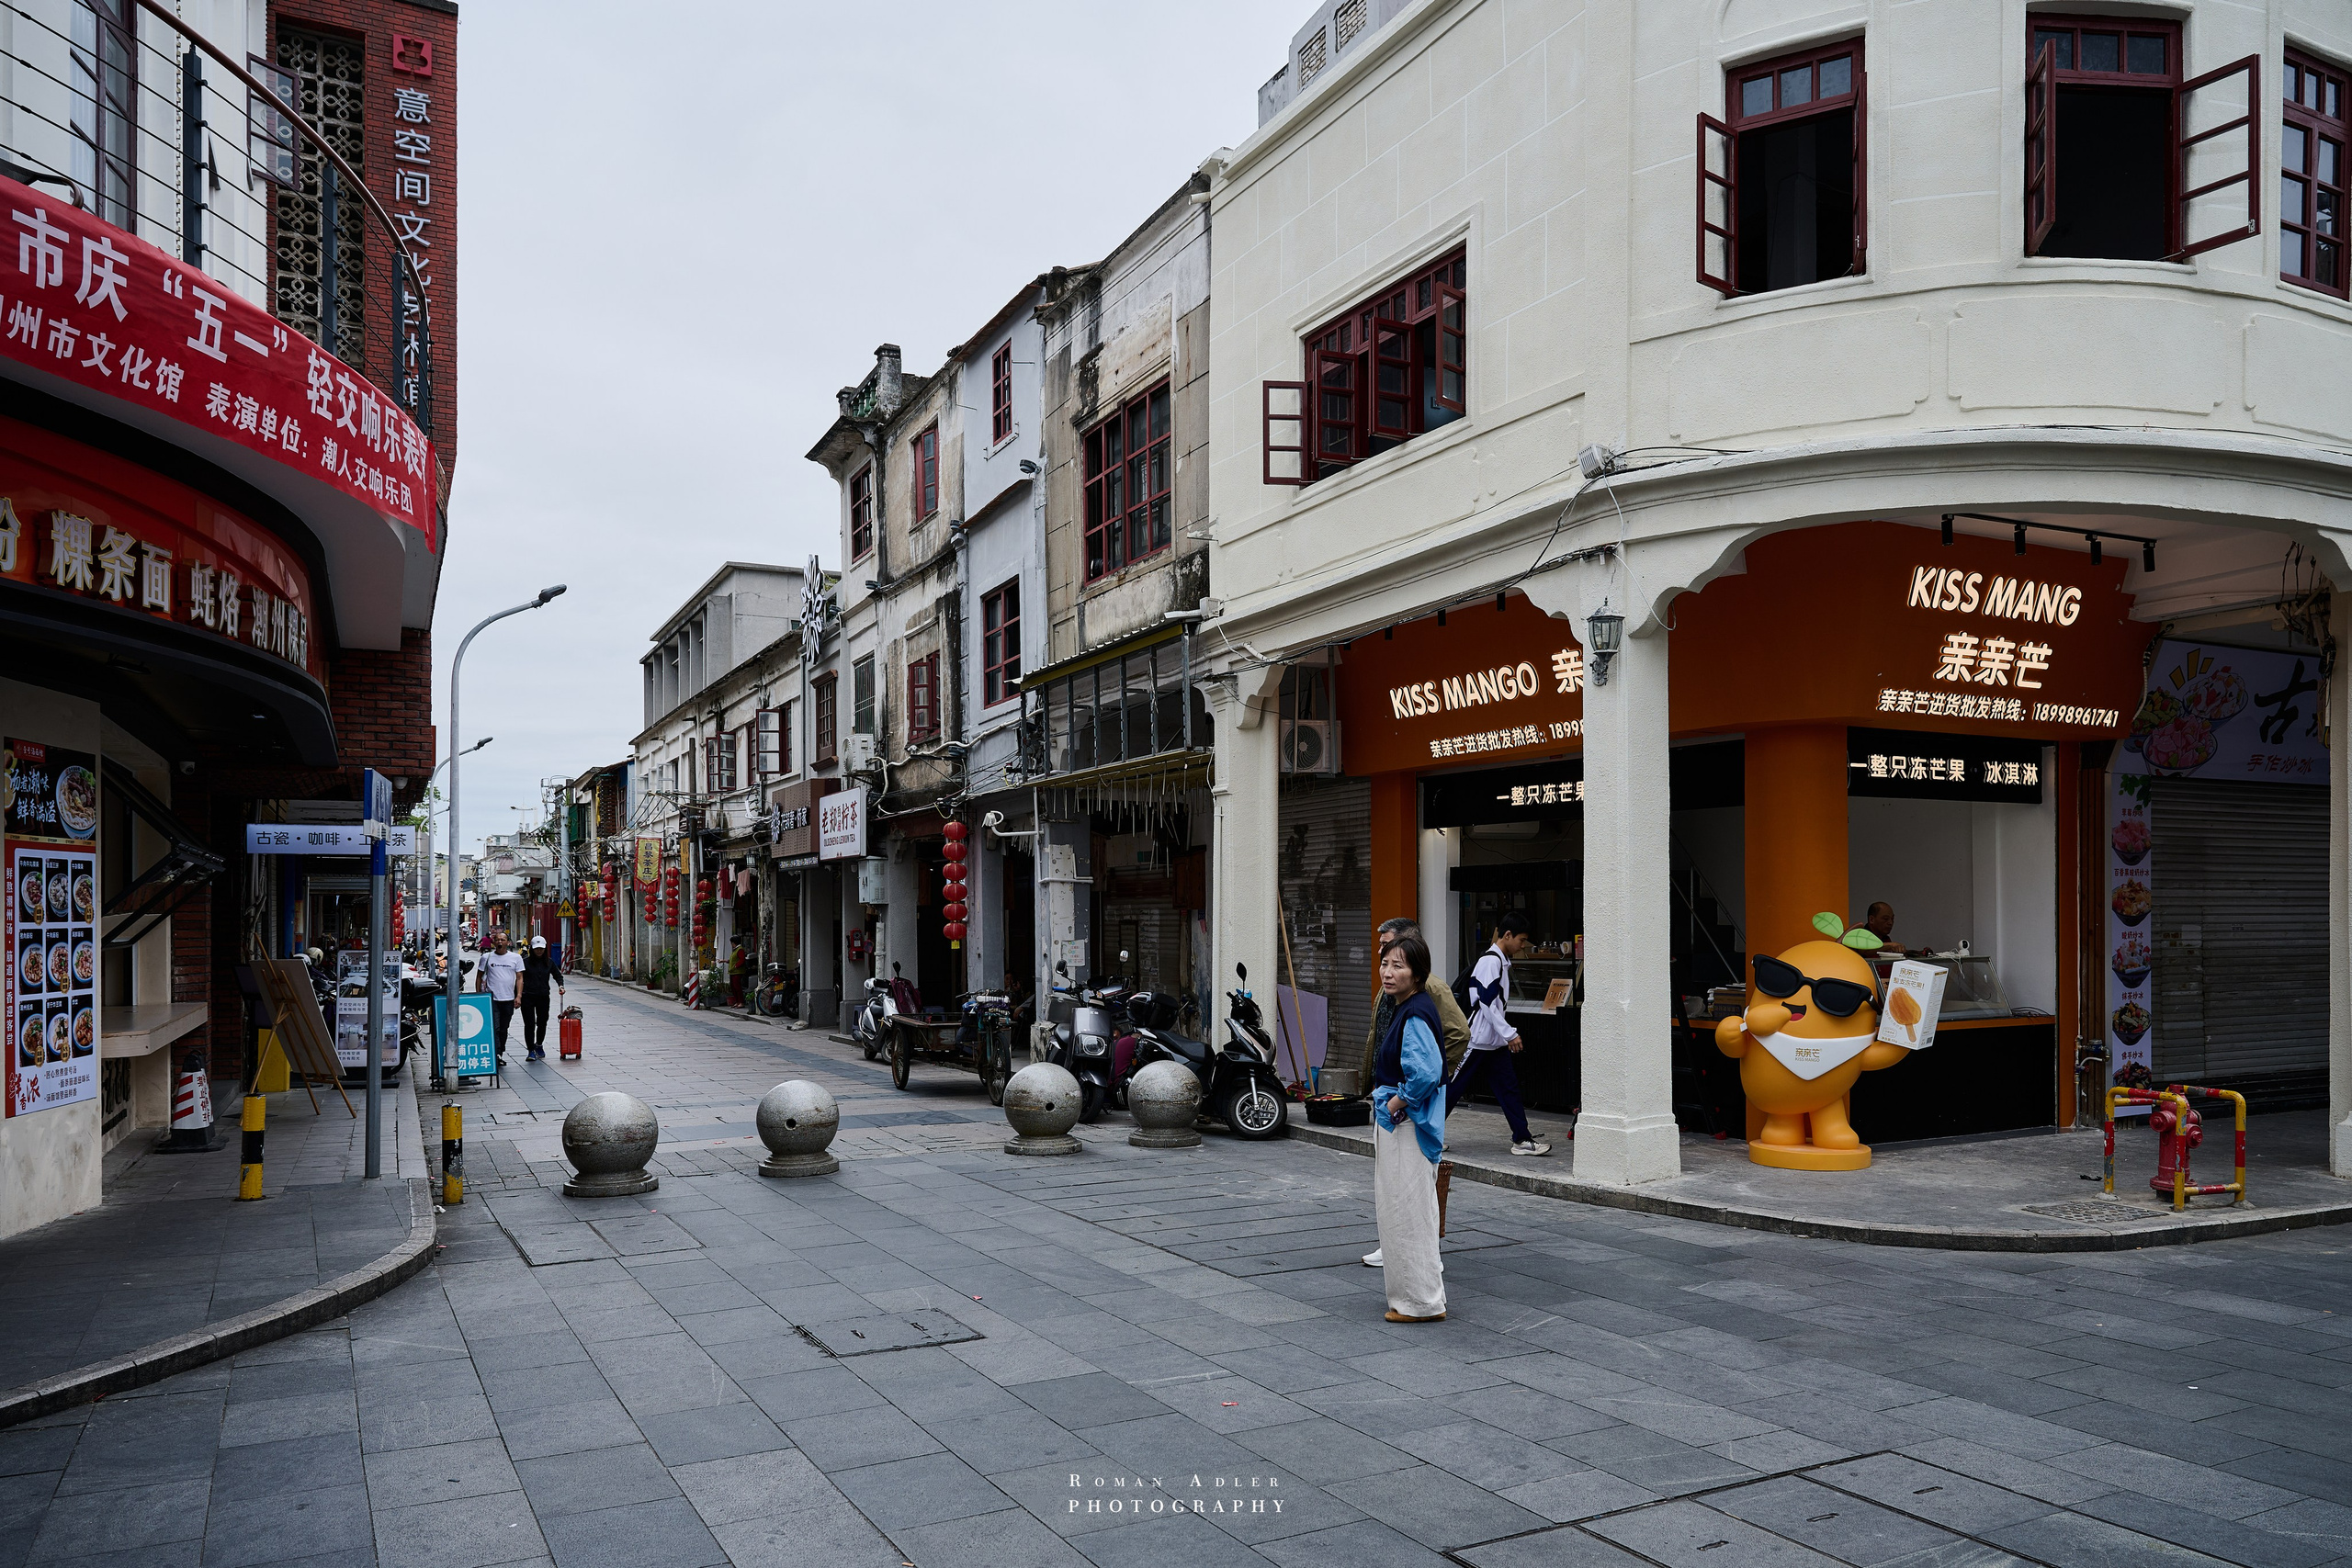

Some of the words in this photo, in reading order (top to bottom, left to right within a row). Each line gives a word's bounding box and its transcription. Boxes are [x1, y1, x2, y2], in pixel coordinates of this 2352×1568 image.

[0, 295, 185, 404] 州市文化馆
[50, 509, 173, 614] 粿条面
[189, 558, 241, 639] 蚝烙
[1908, 565, 1983, 614] KISS
[1983, 575, 2082, 626] MANG
[1934, 631, 2053, 689] 亲亲芒
[1389, 682, 1441, 719] KISS
[1442, 661, 1539, 711] MANGO
[1849, 754, 1965, 782] 一整只冻芒果
[1984, 761, 2039, 786] 冰淇淋
[2247, 753, 2315, 774] 手作炒冰
[255, 831, 407, 847] 古瓷·咖啡·工茶
[2121, 931, 2144, 940] 酸奶炒冰
[1795, 1048, 1820, 1058] 亲亲芒
